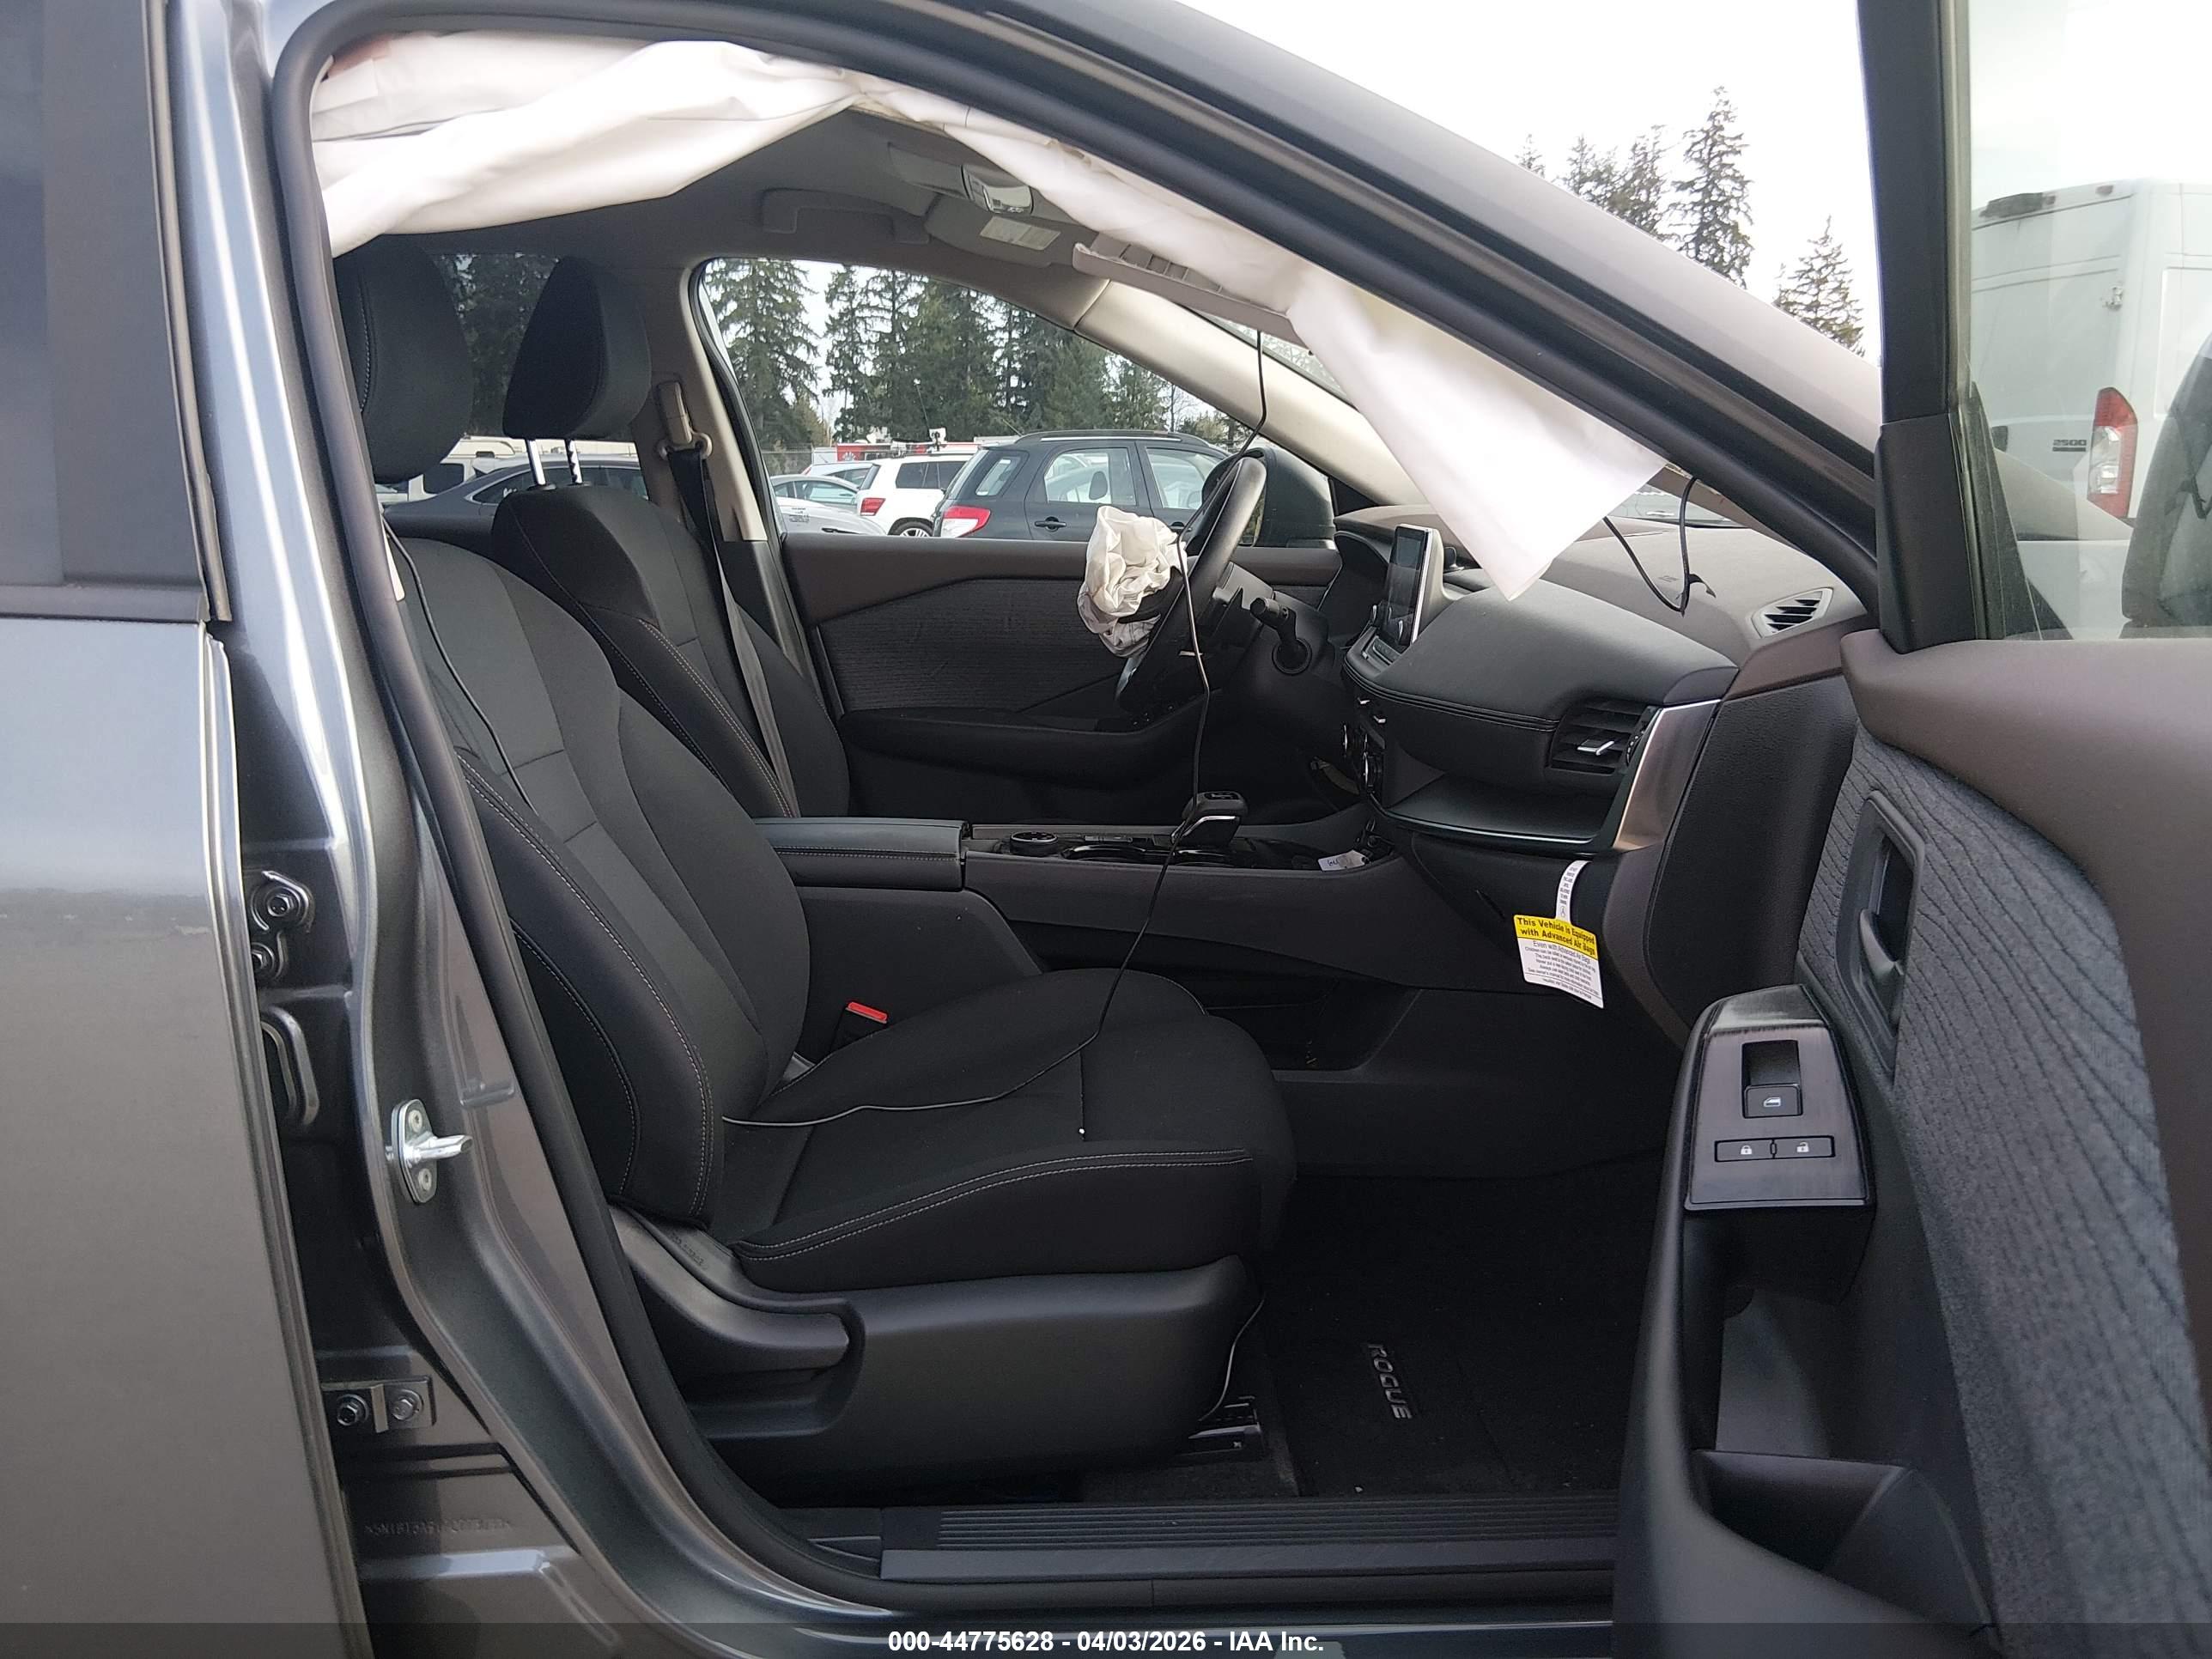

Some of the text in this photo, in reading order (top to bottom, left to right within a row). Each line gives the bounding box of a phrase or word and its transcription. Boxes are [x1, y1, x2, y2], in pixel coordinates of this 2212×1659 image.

[1517, 917, 1536, 927] This
[1539, 920, 1565, 933] Vehicle
[1571, 928, 1595, 945] Equipped
[1521, 928, 1595, 956] with Advanced Air Bags
[1368, 1343, 1413, 1419] ROGUE
